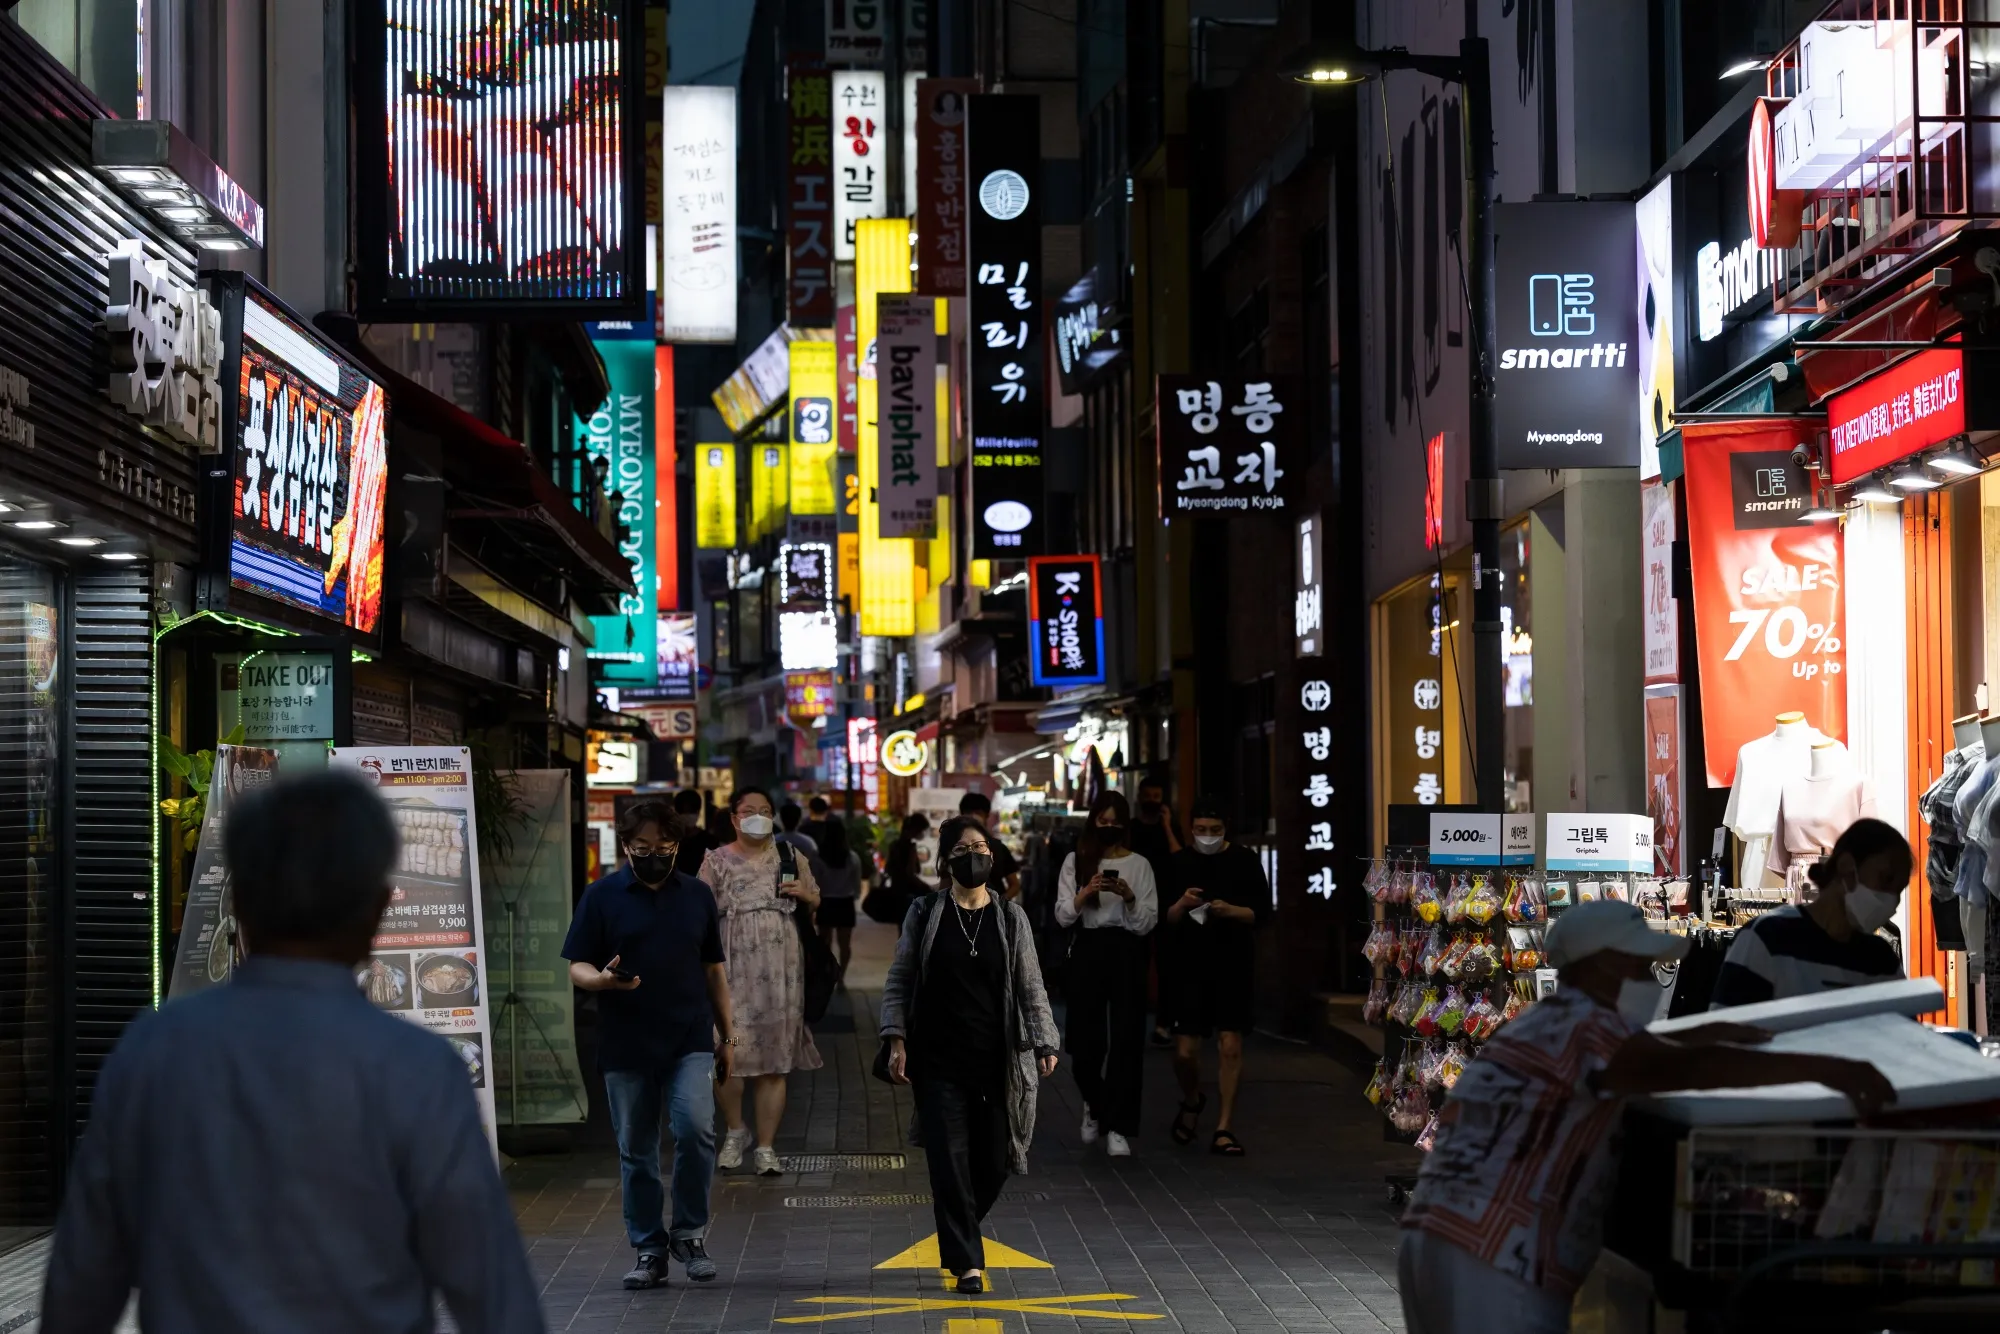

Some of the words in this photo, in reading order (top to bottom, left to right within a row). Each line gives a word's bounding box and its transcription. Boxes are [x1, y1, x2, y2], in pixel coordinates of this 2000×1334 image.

[841, 85, 876, 107] 수원
[791, 76, 829, 308] 横浜エステ
[933, 130, 965, 263] 홍콩반점
[978, 261, 1032, 404] 밀피유
[1500, 343, 1627, 369] smartti
[888, 345, 922, 487] baviphat
[1176, 381, 1283, 434] 명동
[1527, 429, 1603, 445] Myeongdong
[618, 395, 643, 522] MYEONG
[1176, 441, 1285, 493] 교자
[1177, 495, 1248, 509] Myeongdong
[1251, 495, 1285, 509] Kyoja
[1744, 498, 1802, 513] smartti
[1055, 571, 1081, 595] K
[1740, 564, 1820, 596] SALE
[1723, 605, 1842, 662] 70%
[245, 665, 291, 687] TAKE
[296, 665, 332, 687] OUT
[1792, 660, 1819, 681] Up
[1824, 659, 1842, 675] to
[263, 696, 313, 708] 가능합니다
[245, 724, 319, 735] イクアウト可能です。
[392, 757, 413, 772] 반가
[415, 757, 438, 771] 런치
[440, 757, 462, 771] 메뉴
[393, 776, 405, 784] am
[406, 775, 426, 784] 11:00
[433, 777, 445, 787] pm
[446, 774, 462, 784] 2:00
[1302, 726, 1337, 900] 명동교자
[1510, 825, 1528, 840] 에어팟
[1566, 827, 1609, 844] 그립톡
[1576, 847, 1600, 855] Griptok
[395, 905, 420, 916] 바베큐
[421, 903, 447, 916] 삼겹살
[448, 903, 465, 915] 정식
[439, 917, 466, 929] 9,900
[454, 1018, 476, 1028] 8,000
